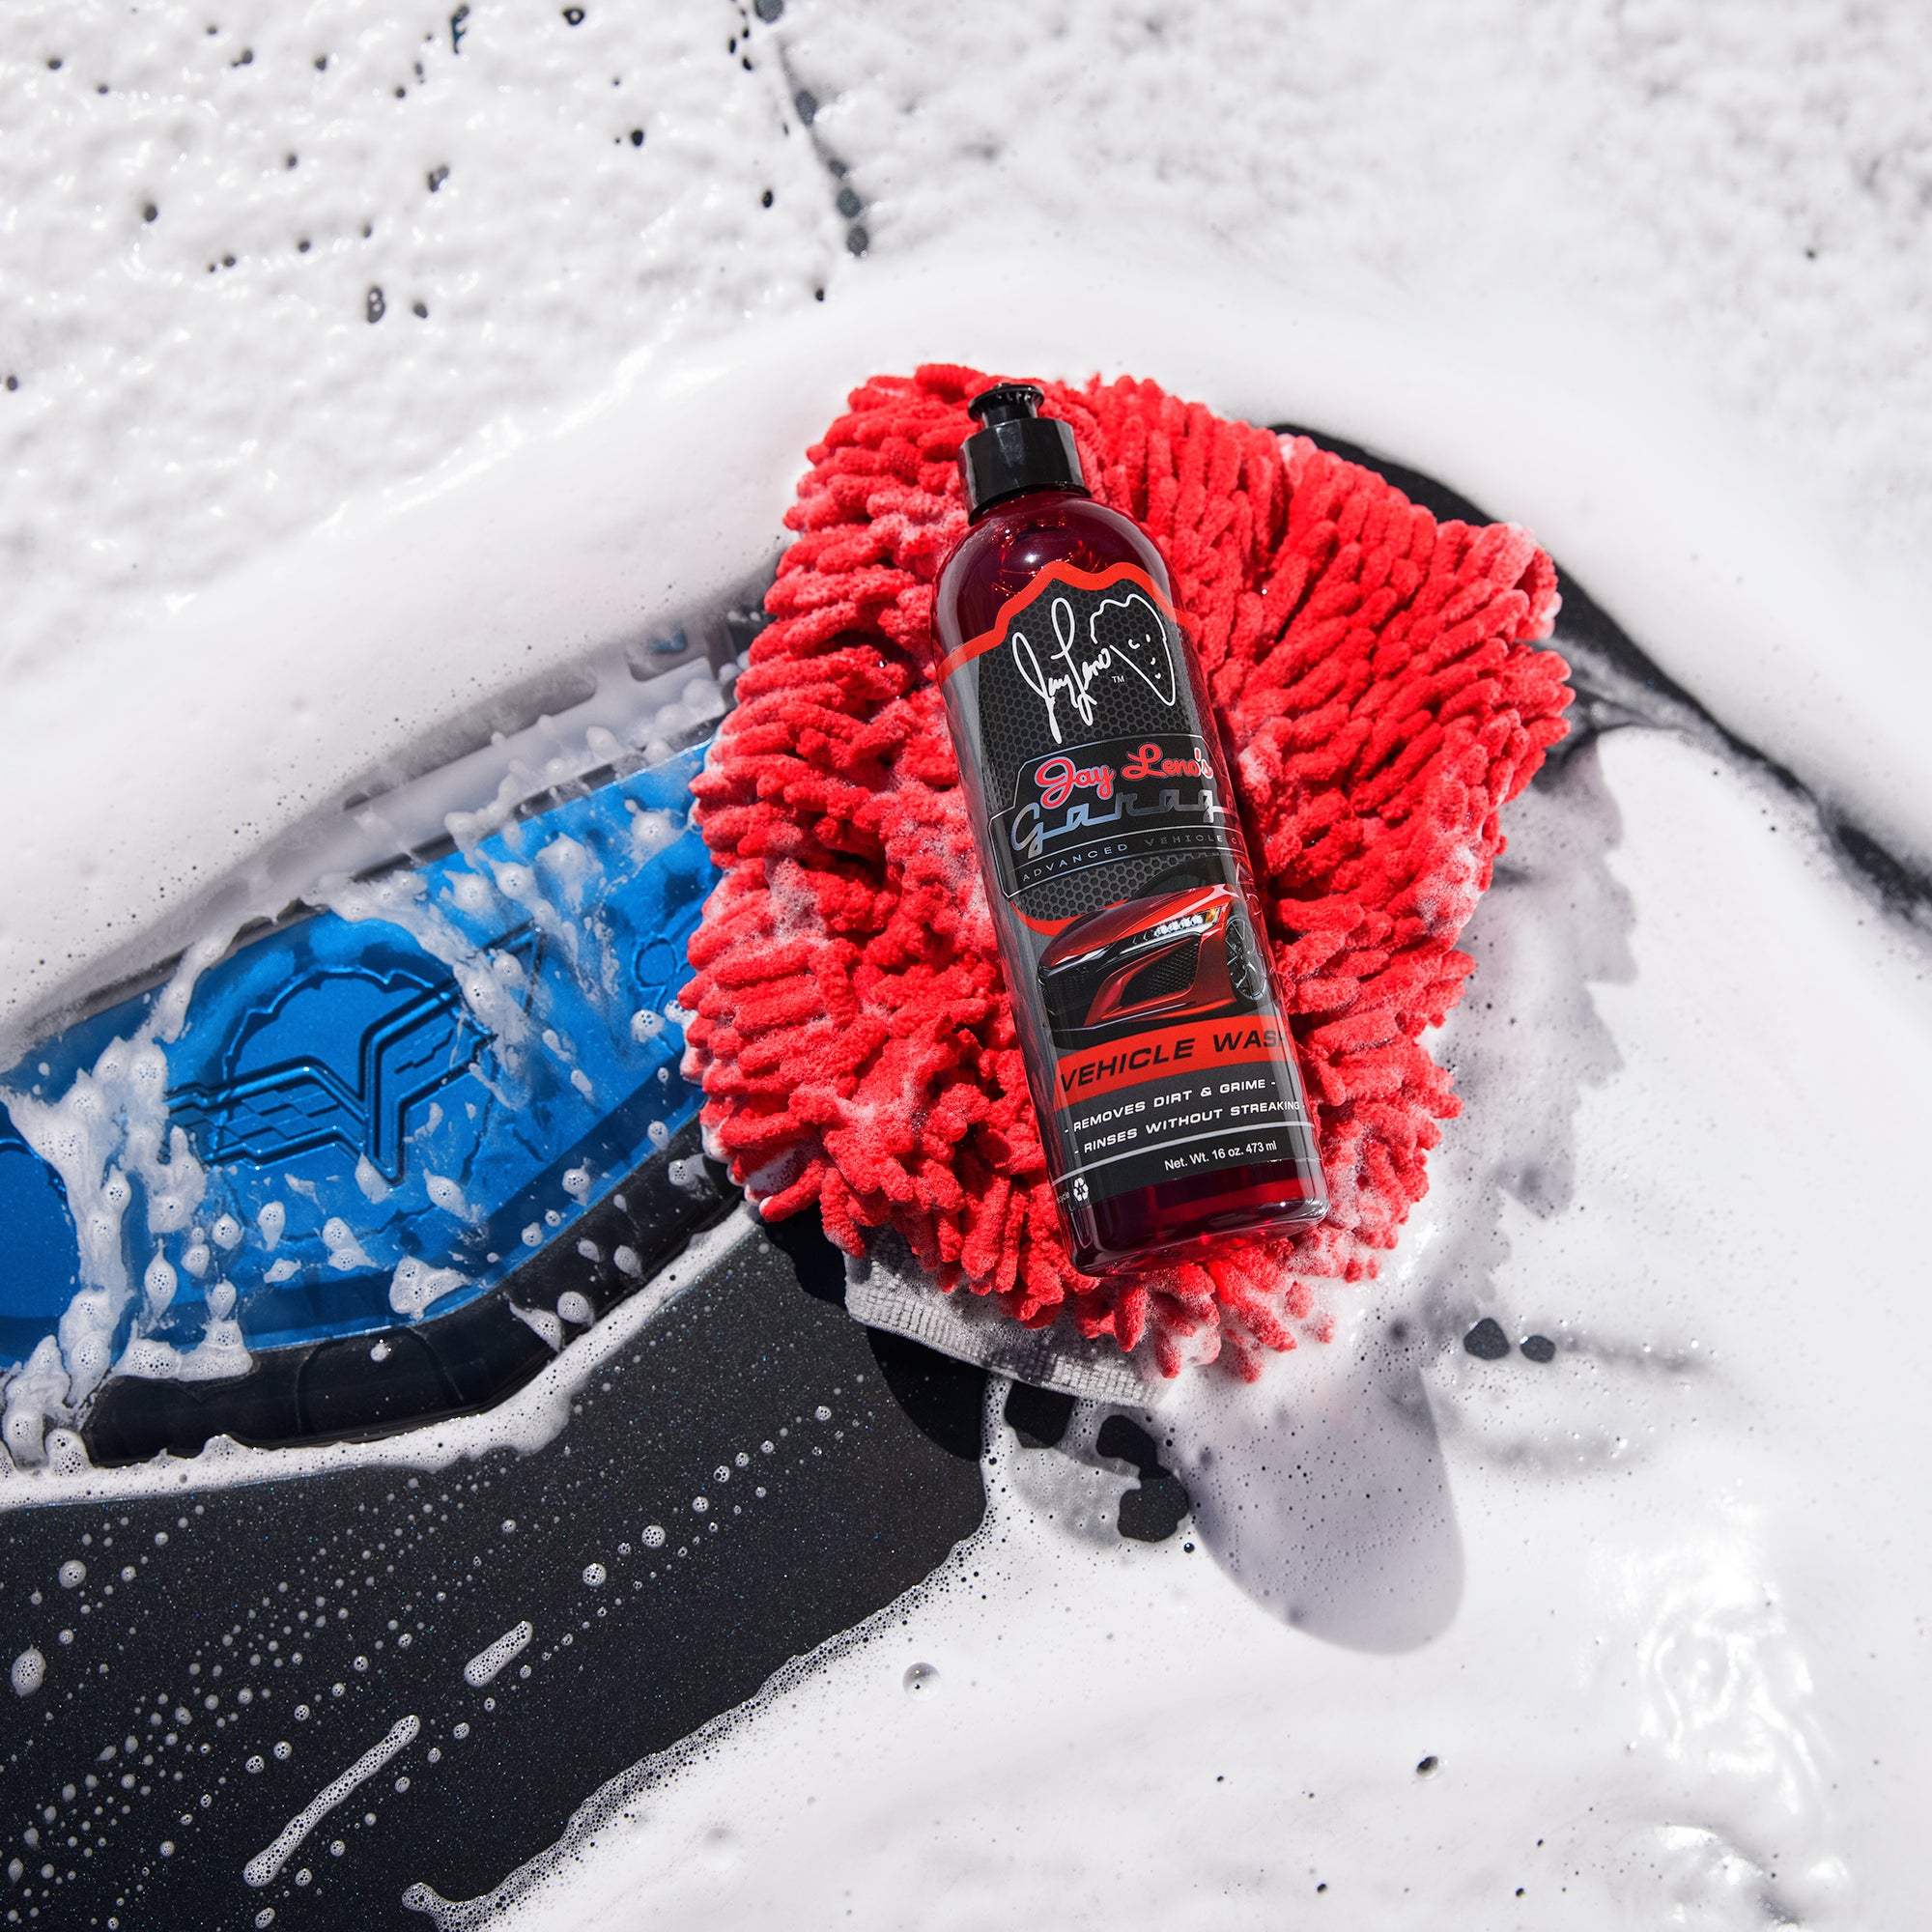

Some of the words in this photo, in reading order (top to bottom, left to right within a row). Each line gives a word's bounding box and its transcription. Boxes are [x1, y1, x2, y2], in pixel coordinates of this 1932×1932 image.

[1034, 756, 1115, 810] Jay
[1121, 743, 1213, 780] Leno's
[1022, 843, 1128, 883] ADVANCED
[1145, 835, 1223, 847] VEHICLE
[1060, 1037, 1196, 1093] VEHICLE
[1073, 1101, 1147, 1132] REMOVES
[1153, 1090, 1192, 1108] DIRT
[1200, 1087, 1212, 1097] &
[1219, 1079, 1266, 1094] GRIME
[1084, 1128, 1138, 1153] RINSES
[1145, 1109, 1223, 1135] WITHOUT
[1230, 1100, 1300, 1117] STREAKING
[1164, 1157, 1188, 1171] Net.
[1189, 1152, 1209, 1165] Wt.
[1211, 1148, 1226, 1160] 16
[1227, 1147, 1244, 1157] oz.
[1245, 1141, 1264, 1154] 473
[1265, 1140, 1277, 1151] ml
